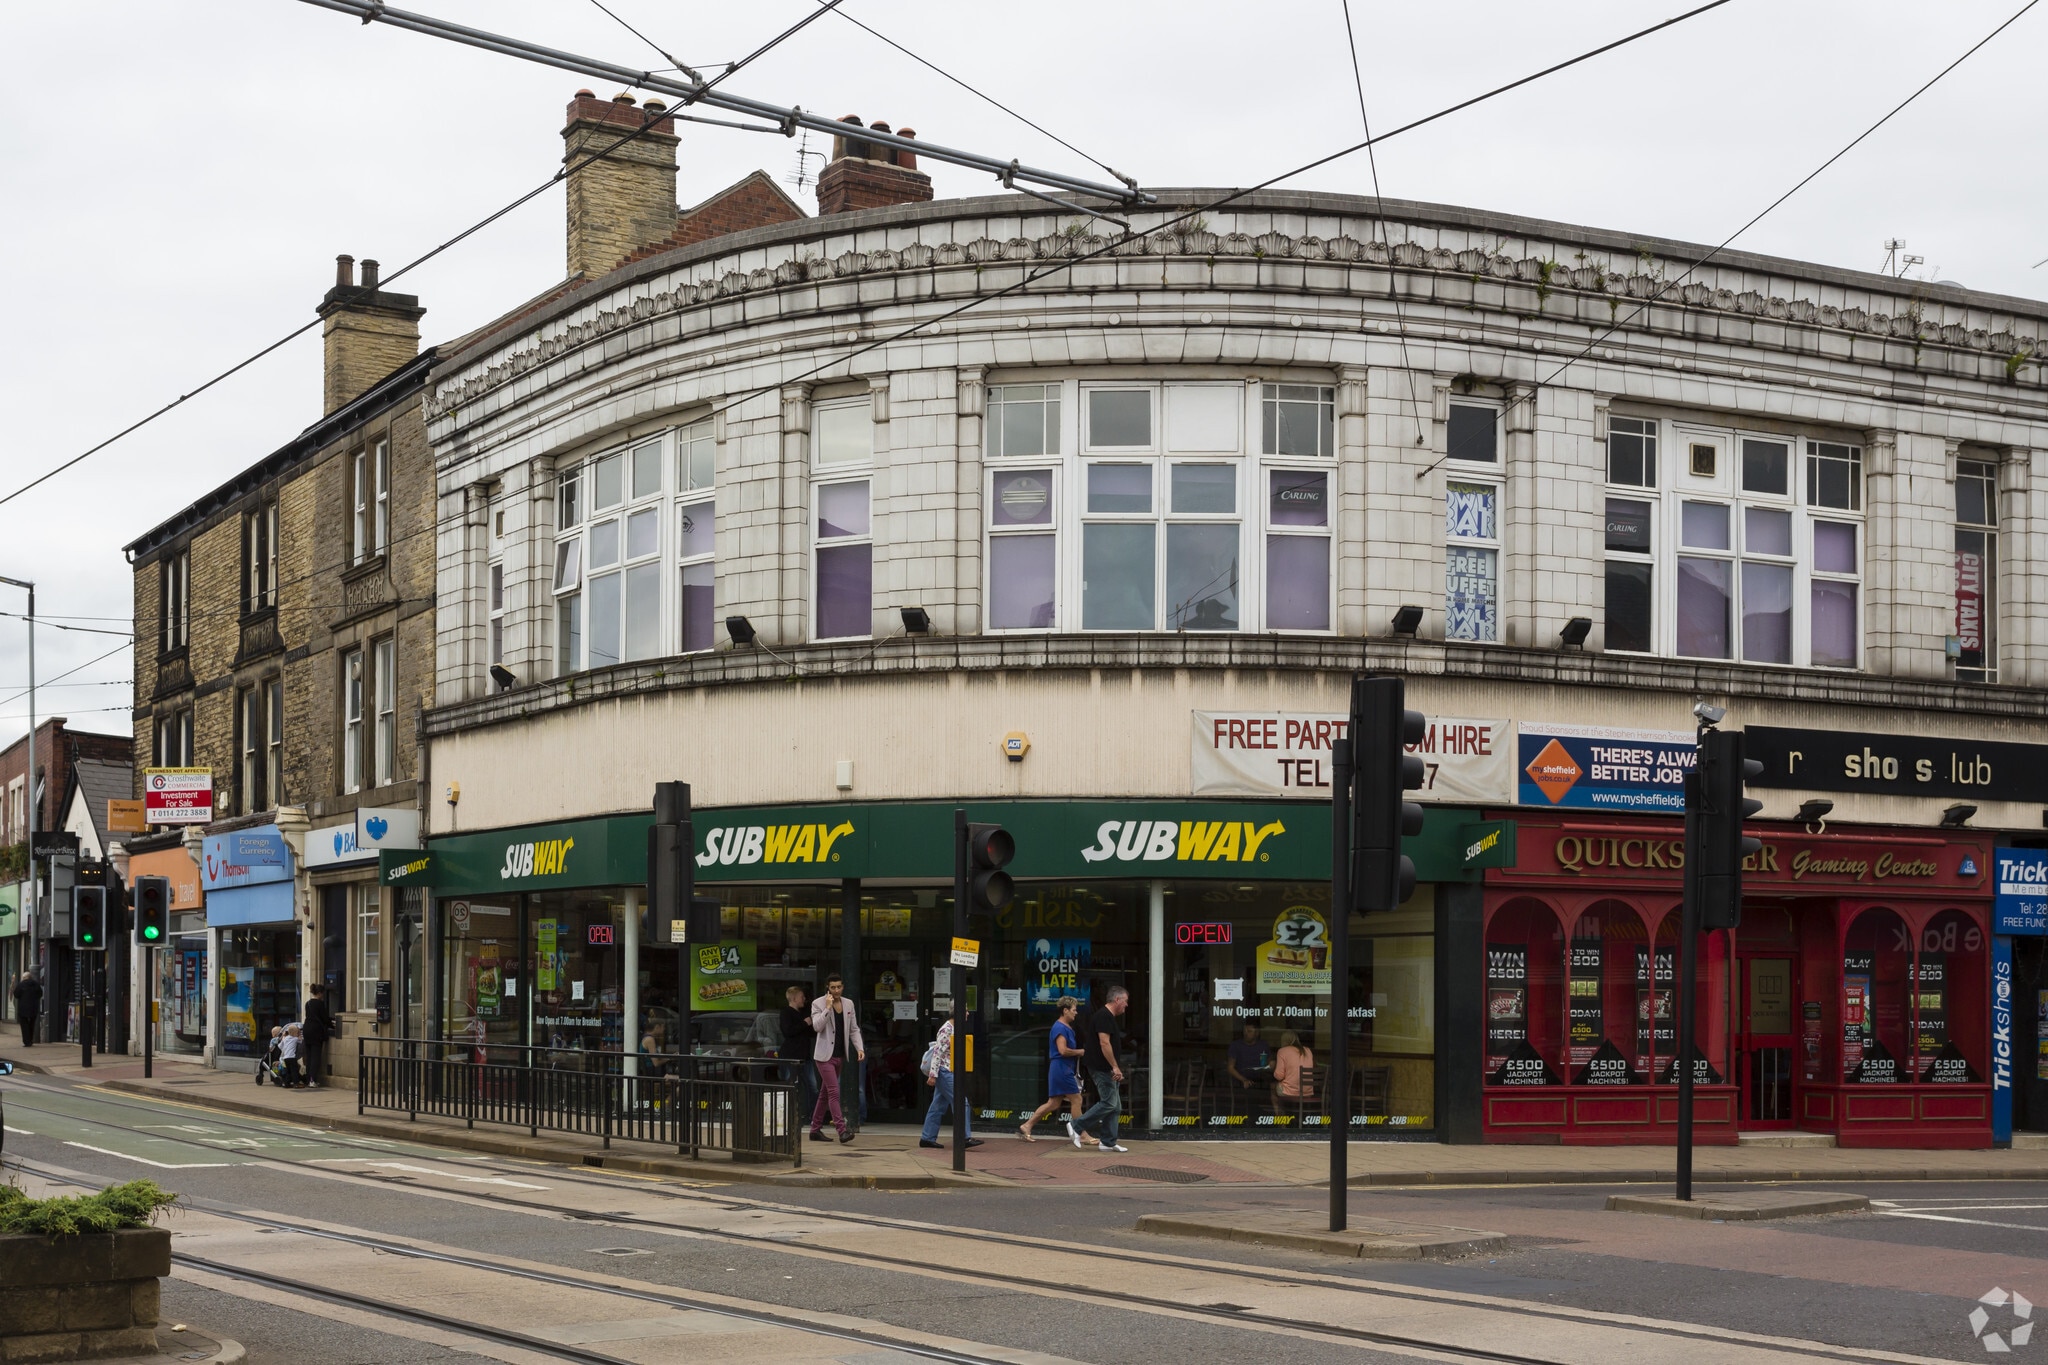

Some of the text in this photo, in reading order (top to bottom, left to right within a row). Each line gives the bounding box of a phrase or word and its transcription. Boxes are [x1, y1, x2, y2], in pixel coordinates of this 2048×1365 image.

[1281, 490, 1319, 500] CARLING
[1606, 521, 1638, 534] CARLING
[1446, 575, 1496, 596] UFFET
[1960, 553, 1979, 649] CITY TAXIS
[1214, 719, 1278, 750] FREE
[1285, 720, 1350, 751] PART
[1443, 726, 1492, 756] HIRE
[1520, 723, 1543, 733] Proud
[1545, 725, 1580, 736] Sponsors
[1581, 727, 1590, 736] of
[1590, 727, 1602, 737] the
[1605, 729, 1636, 740] Stephen
[1637, 731, 1667, 741] Harrison
[1008, 740, 1021, 748] ADT
[1591, 746, 1697, 768] THERE'S ALWA
[1278, 759, 1330, 787] TEL
[1532, 765, 1576, 776] mysheffield
[1591, 764, 1650, 783] BETTER
[1538, 774, 1571, 783] jobs.co.uk
[239, 837, 270, 848] Foreign
[695, 819, 855, 868] SUBWAY
[1080, 818, 1286, 863] SUBWAY
[1465, 830, 1500, 861] SUBWAY
[239, 846, 276, 857] Currency
[500, 836, 574, 880] SUBWAY
[387, 857, 430, 880] SUBWAY
[1790, 850, 1869, 880] Gaming
[1873, 852, 1938, 880] Centre
[179, 881, 194, 903] travel
[2019, 902, 2034, 914] Tel:
[2003, 917, 2024, 927] FREE
[589, 926, 613, 943] OPEN
[1177, 924, 1231, 943] OPEN
[1276, 920, 1324, 946] £2
[701, 946, 741, 966] ANY £4
[1489, 951, 1524, 968] WIN
[702, 958, 720, 967] SUB
[1038, 959, 1078, 973] OPEN
[1844, 958, 1871, 968] PLAY
[1263, 971, 1285, 979] BACON
[1286, 971, 1299, 979] SUB
[1489, 968, 1525, 979] £500
[1041, 974, 1076, 988] LATE
[1213, 1006, 1377, 1019] Now Open at 7.00am for akfast
[1569, 1009, 1601, 1018] ODAY!
[536, 1016, 544, 1025] Now
[545, 1016, 555, 1027] Open
[555, 1017, 560, 1025] at
[582, 1017, 602, 1027] Breakfast
[1910, 1020, 1944, 1029] TDAY!
[1490, 1029, 1526, 1040] HERE!
[1639, 1029, 1674, 1039] HRE!
[1506, 1059, 1544, 1070] £500
[1590, 1060, 1626, 1070] £500
[1862, 1059, 1895, 1069] £500
[1934, 1059, 1966, 1069] £500
[980, 1109, 1013, 1119] SUBWAY
[1160, 1115, 1200, 1126] SUBWAY
[1208, 1115, 1248, 1125] SUBWAY
[1255, 1115, 1295, 1125] SUBWAY
[1349, 1115, 1389, 1125] SUBWAY
[1389, 1115, 1428, 1125] SUBWAY
